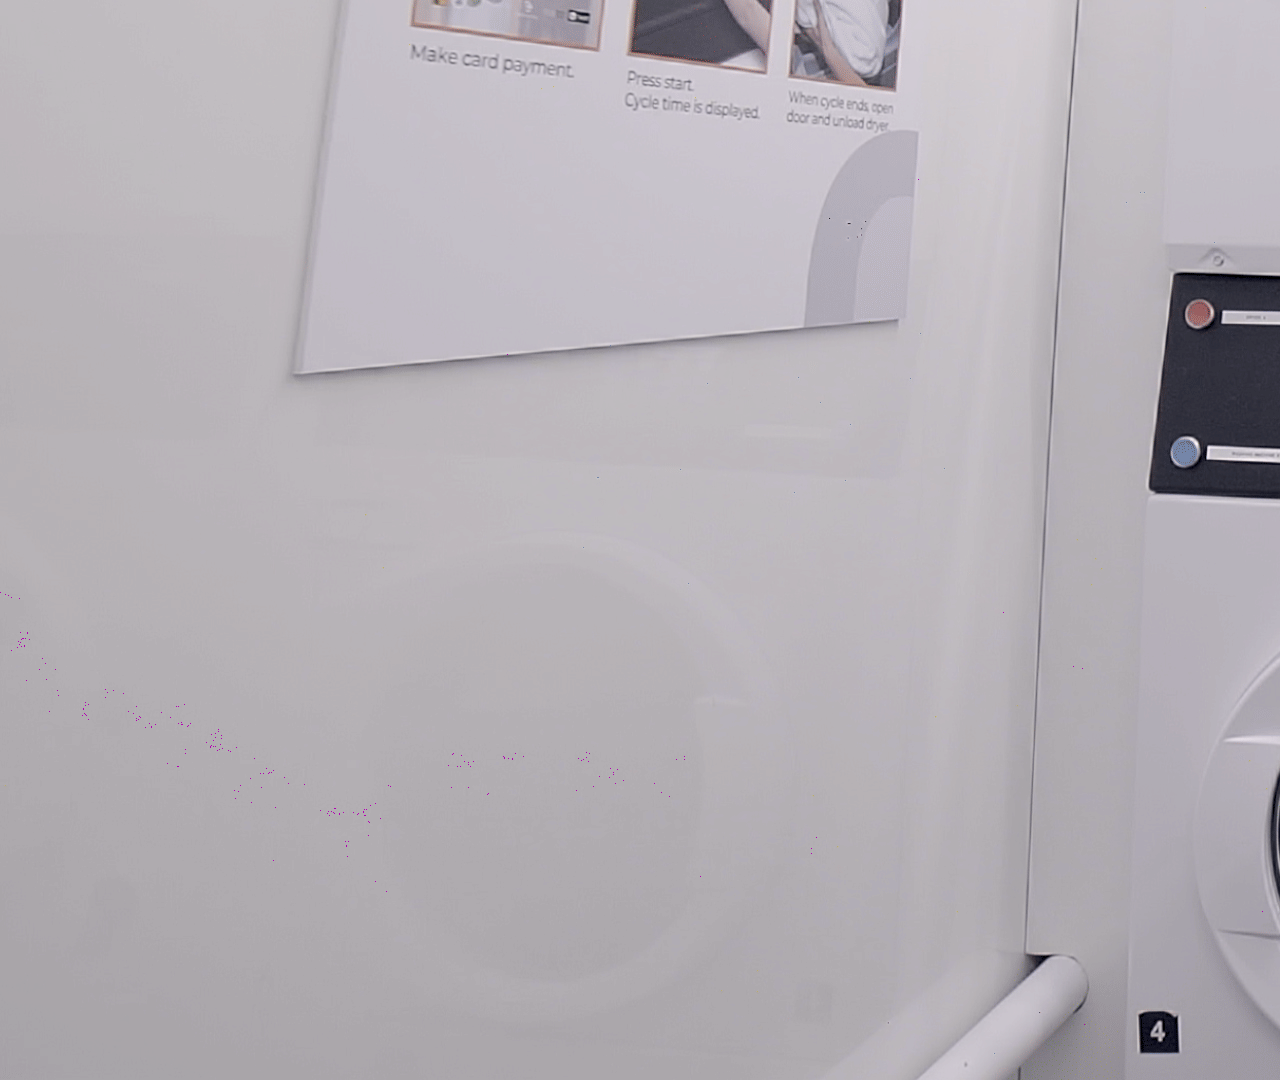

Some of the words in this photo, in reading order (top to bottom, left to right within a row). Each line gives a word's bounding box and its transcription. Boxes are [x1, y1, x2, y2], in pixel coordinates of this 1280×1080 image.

[410, 44, 458, 65] Make
[462, 53, 498, 70] card
[627, 70, 661, 88] Press
[664, 75, 694, 91] start.
[624, 92, 659, 111] Cycle
[662, 97, 690, 112] time
[694, 100, 702, 113] is
[705, 101, 760, 120] displayed.
[788, 91, 818, 106] When
[821, 94, 845, 110] cycle
[871, 102, 893, 116] open
[787, 110, 810, 124] door
[812, 113, 830, 126] and
[1150, 1020, 1166, 1042] 4
